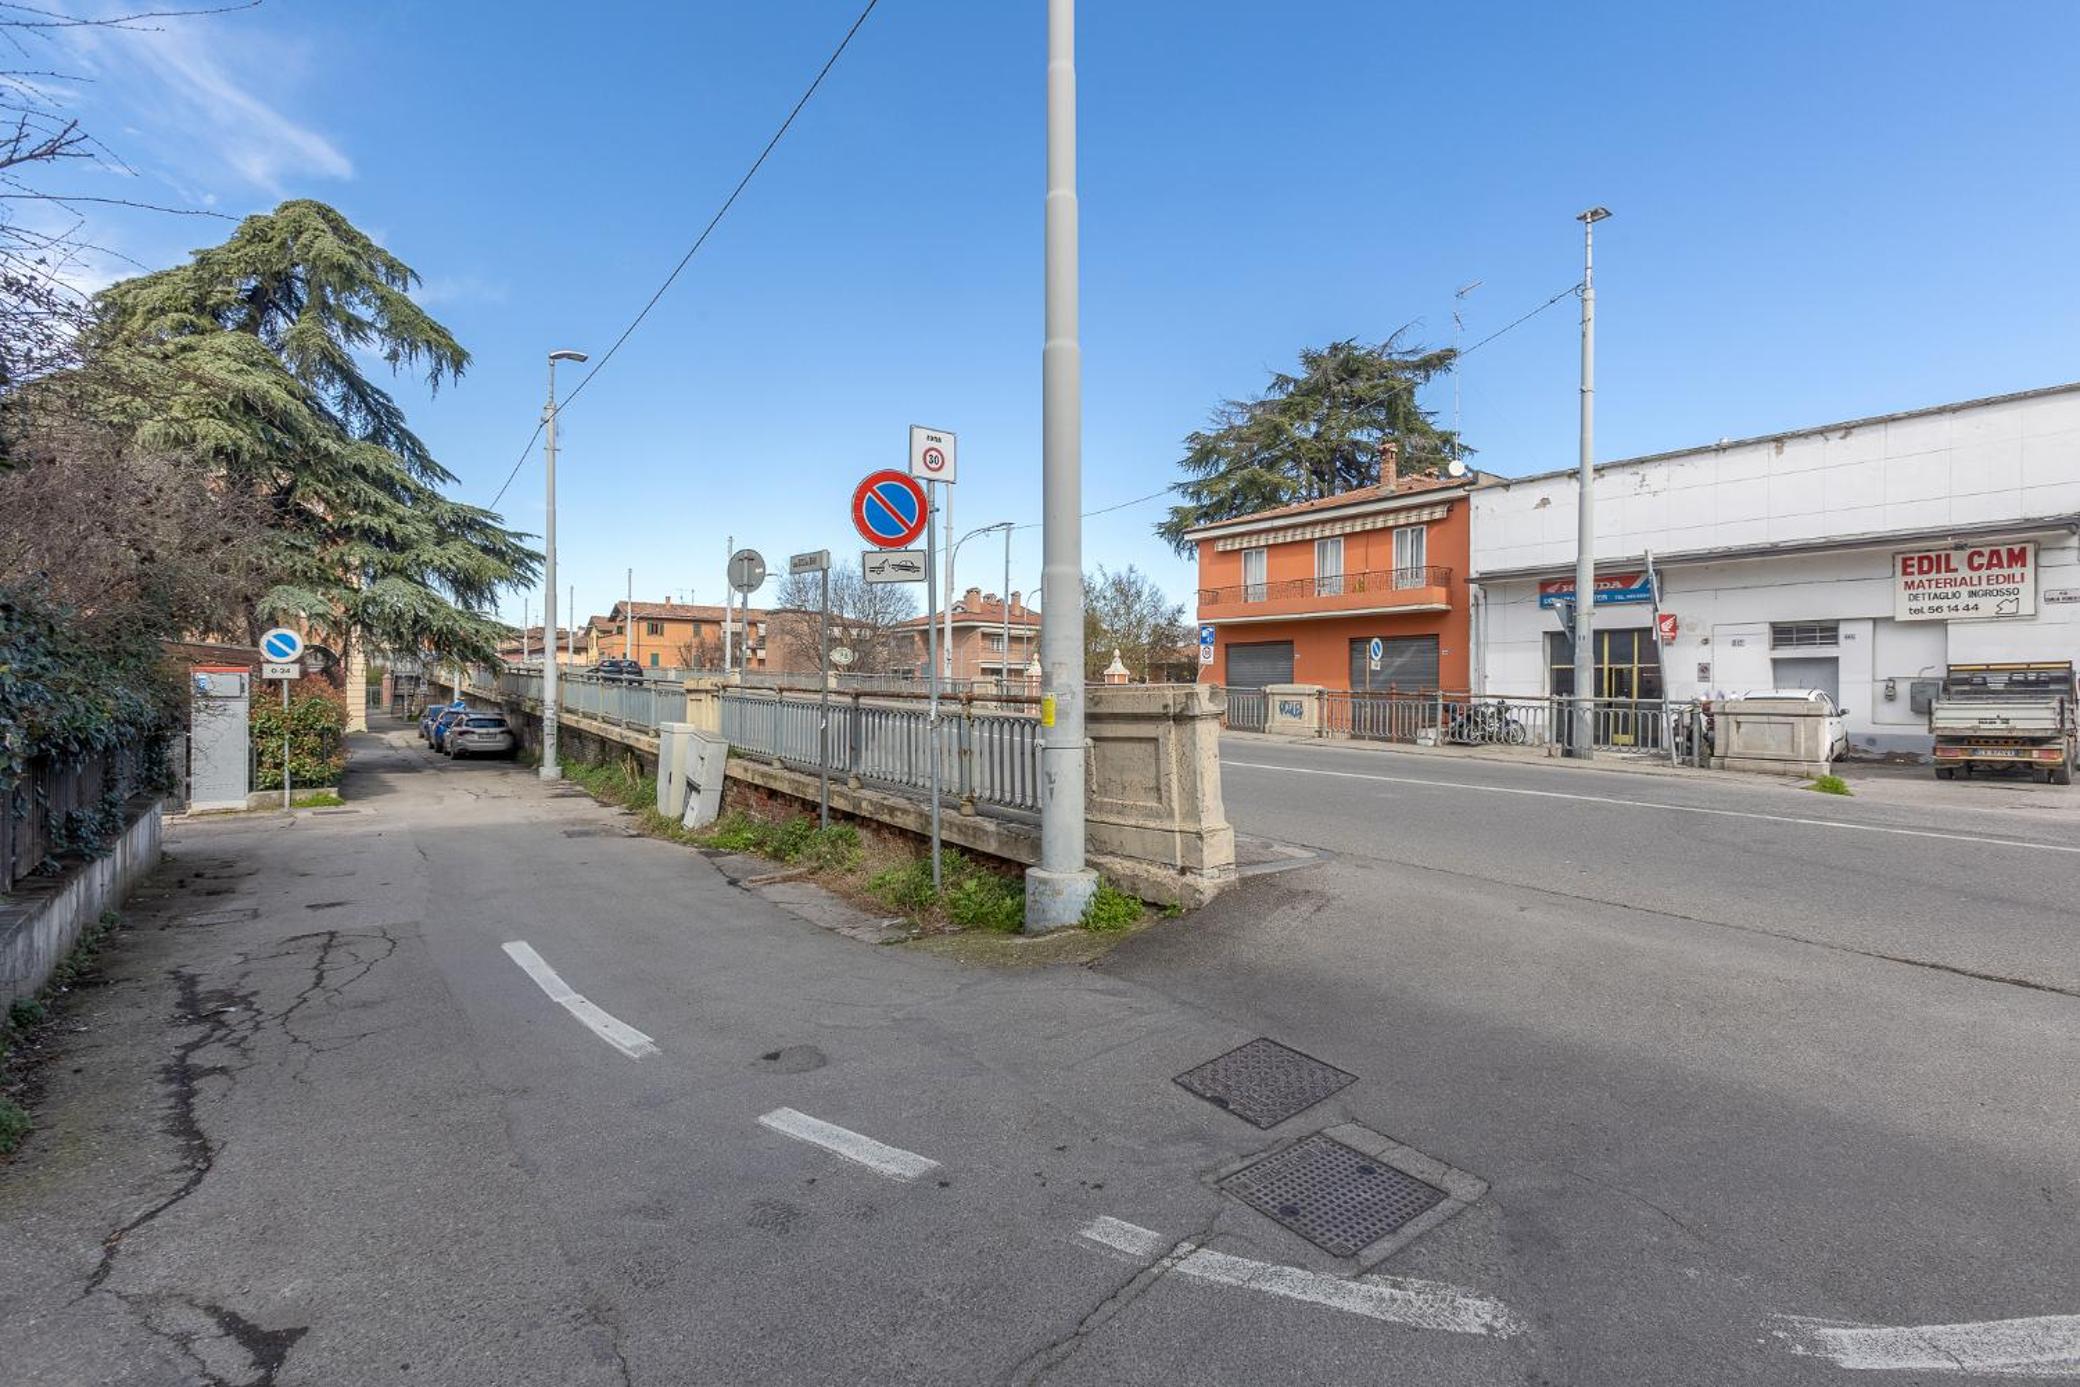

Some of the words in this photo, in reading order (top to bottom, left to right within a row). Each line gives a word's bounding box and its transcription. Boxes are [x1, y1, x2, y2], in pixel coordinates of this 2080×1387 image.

[929, 455, 939, 465] 30
[1901, 553, 1958, 576] EDIL
[1967, 546, 2027, 572] CAM
[1903, 576, 1982, 591] MATERIALI
[1986, 572, 2025, 586] EDILI
[1908, 590, 1962, 602] DETTAGLIO
[1967, 587, 2020, 599] INGROSSO
[1927, 605, 1944, 614] 56
[1947, 604, 1959, 613] 14
[1962, 603, 1980, 612] 44
